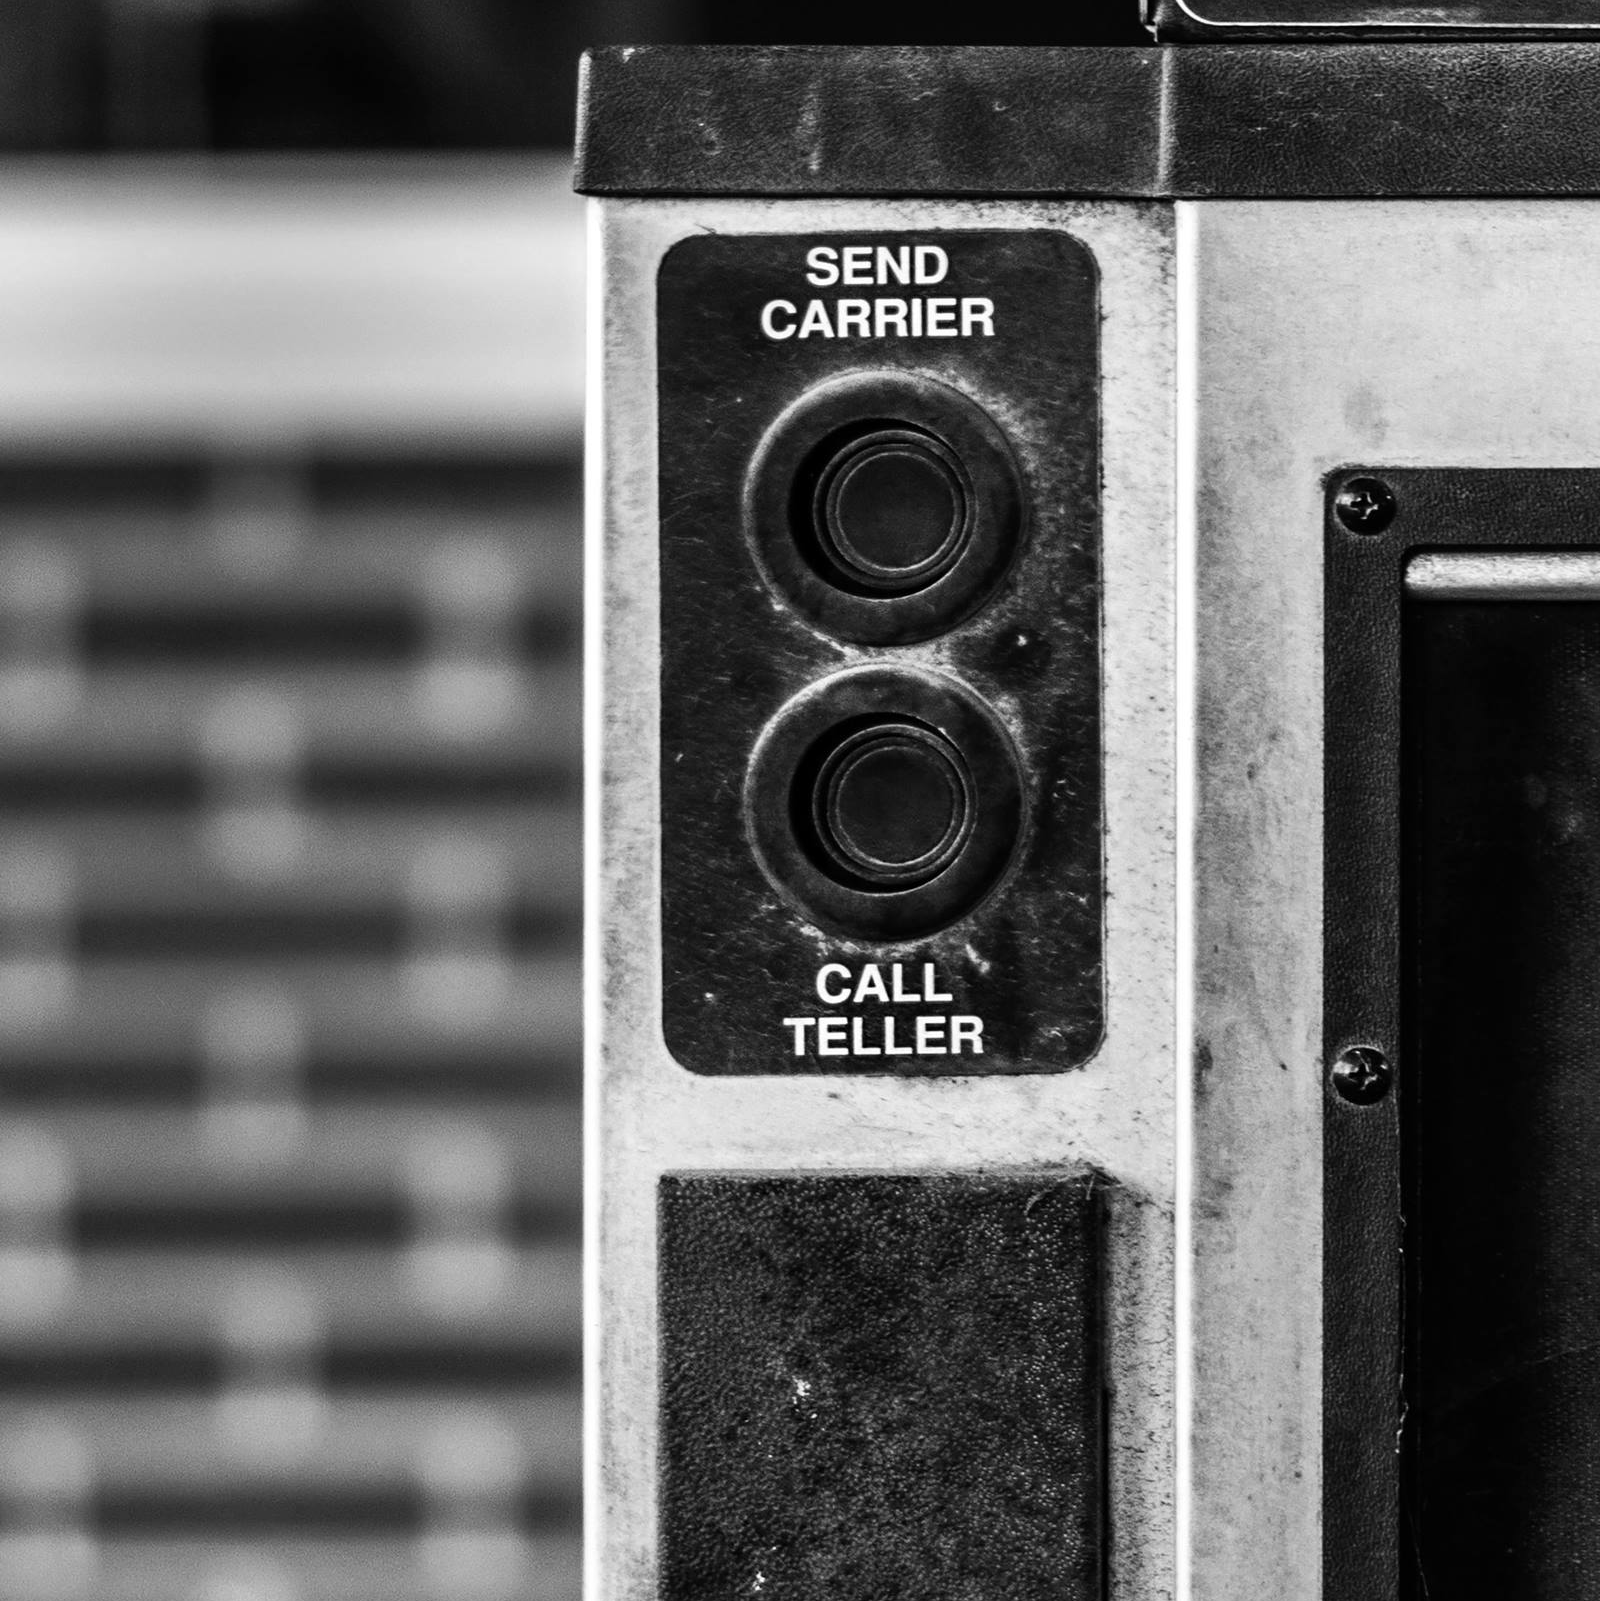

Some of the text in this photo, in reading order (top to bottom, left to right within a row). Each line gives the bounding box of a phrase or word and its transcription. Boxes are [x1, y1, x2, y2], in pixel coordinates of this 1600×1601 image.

[805, 245, 950, 287] SEND
[759, 297, 996, 340] CARRIER
[815, 961, 954, 1005] CALL
[783, 1014, 985, 1057] TELLER
